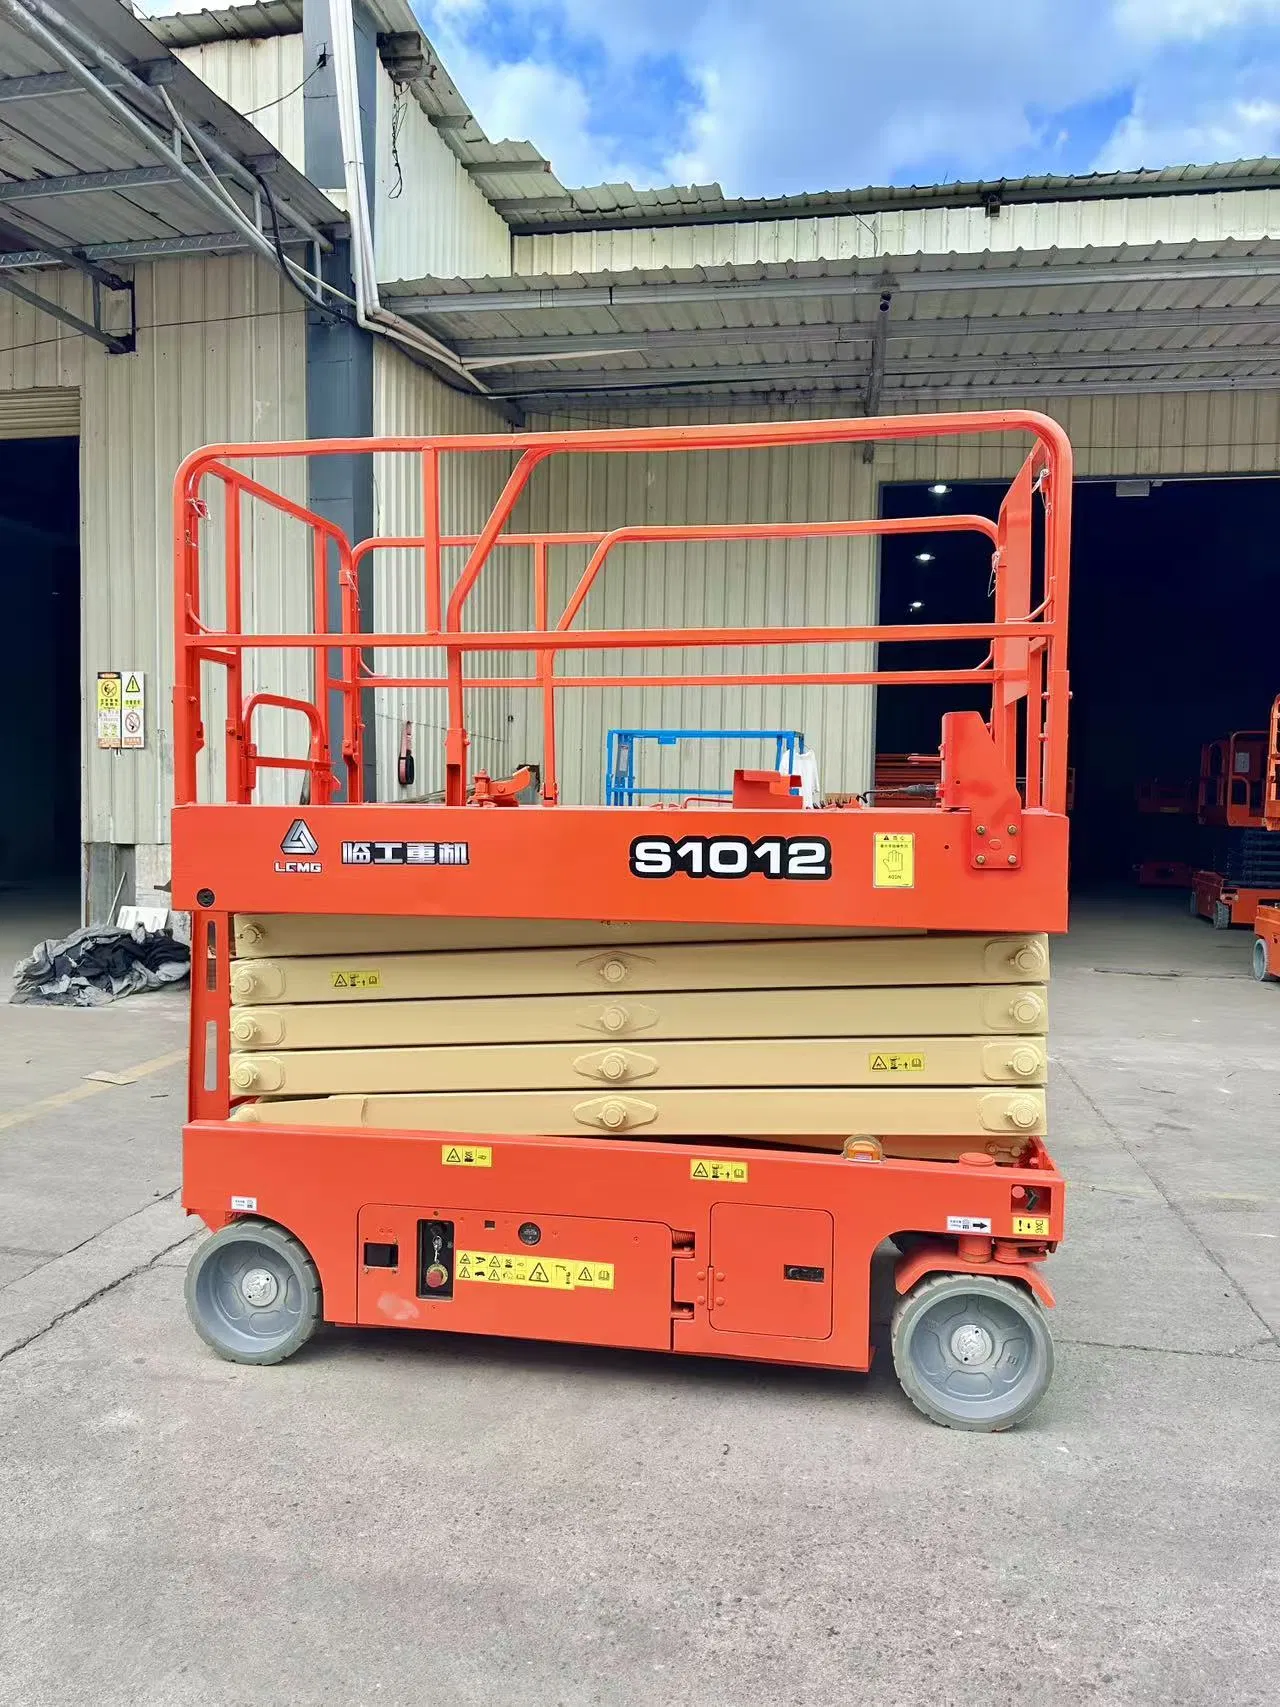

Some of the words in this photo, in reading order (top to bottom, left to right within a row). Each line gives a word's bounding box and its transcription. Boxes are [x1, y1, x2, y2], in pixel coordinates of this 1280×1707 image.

[341, 841, 470, 864] 临工重机
[632, 838, 829, 877] S1012
